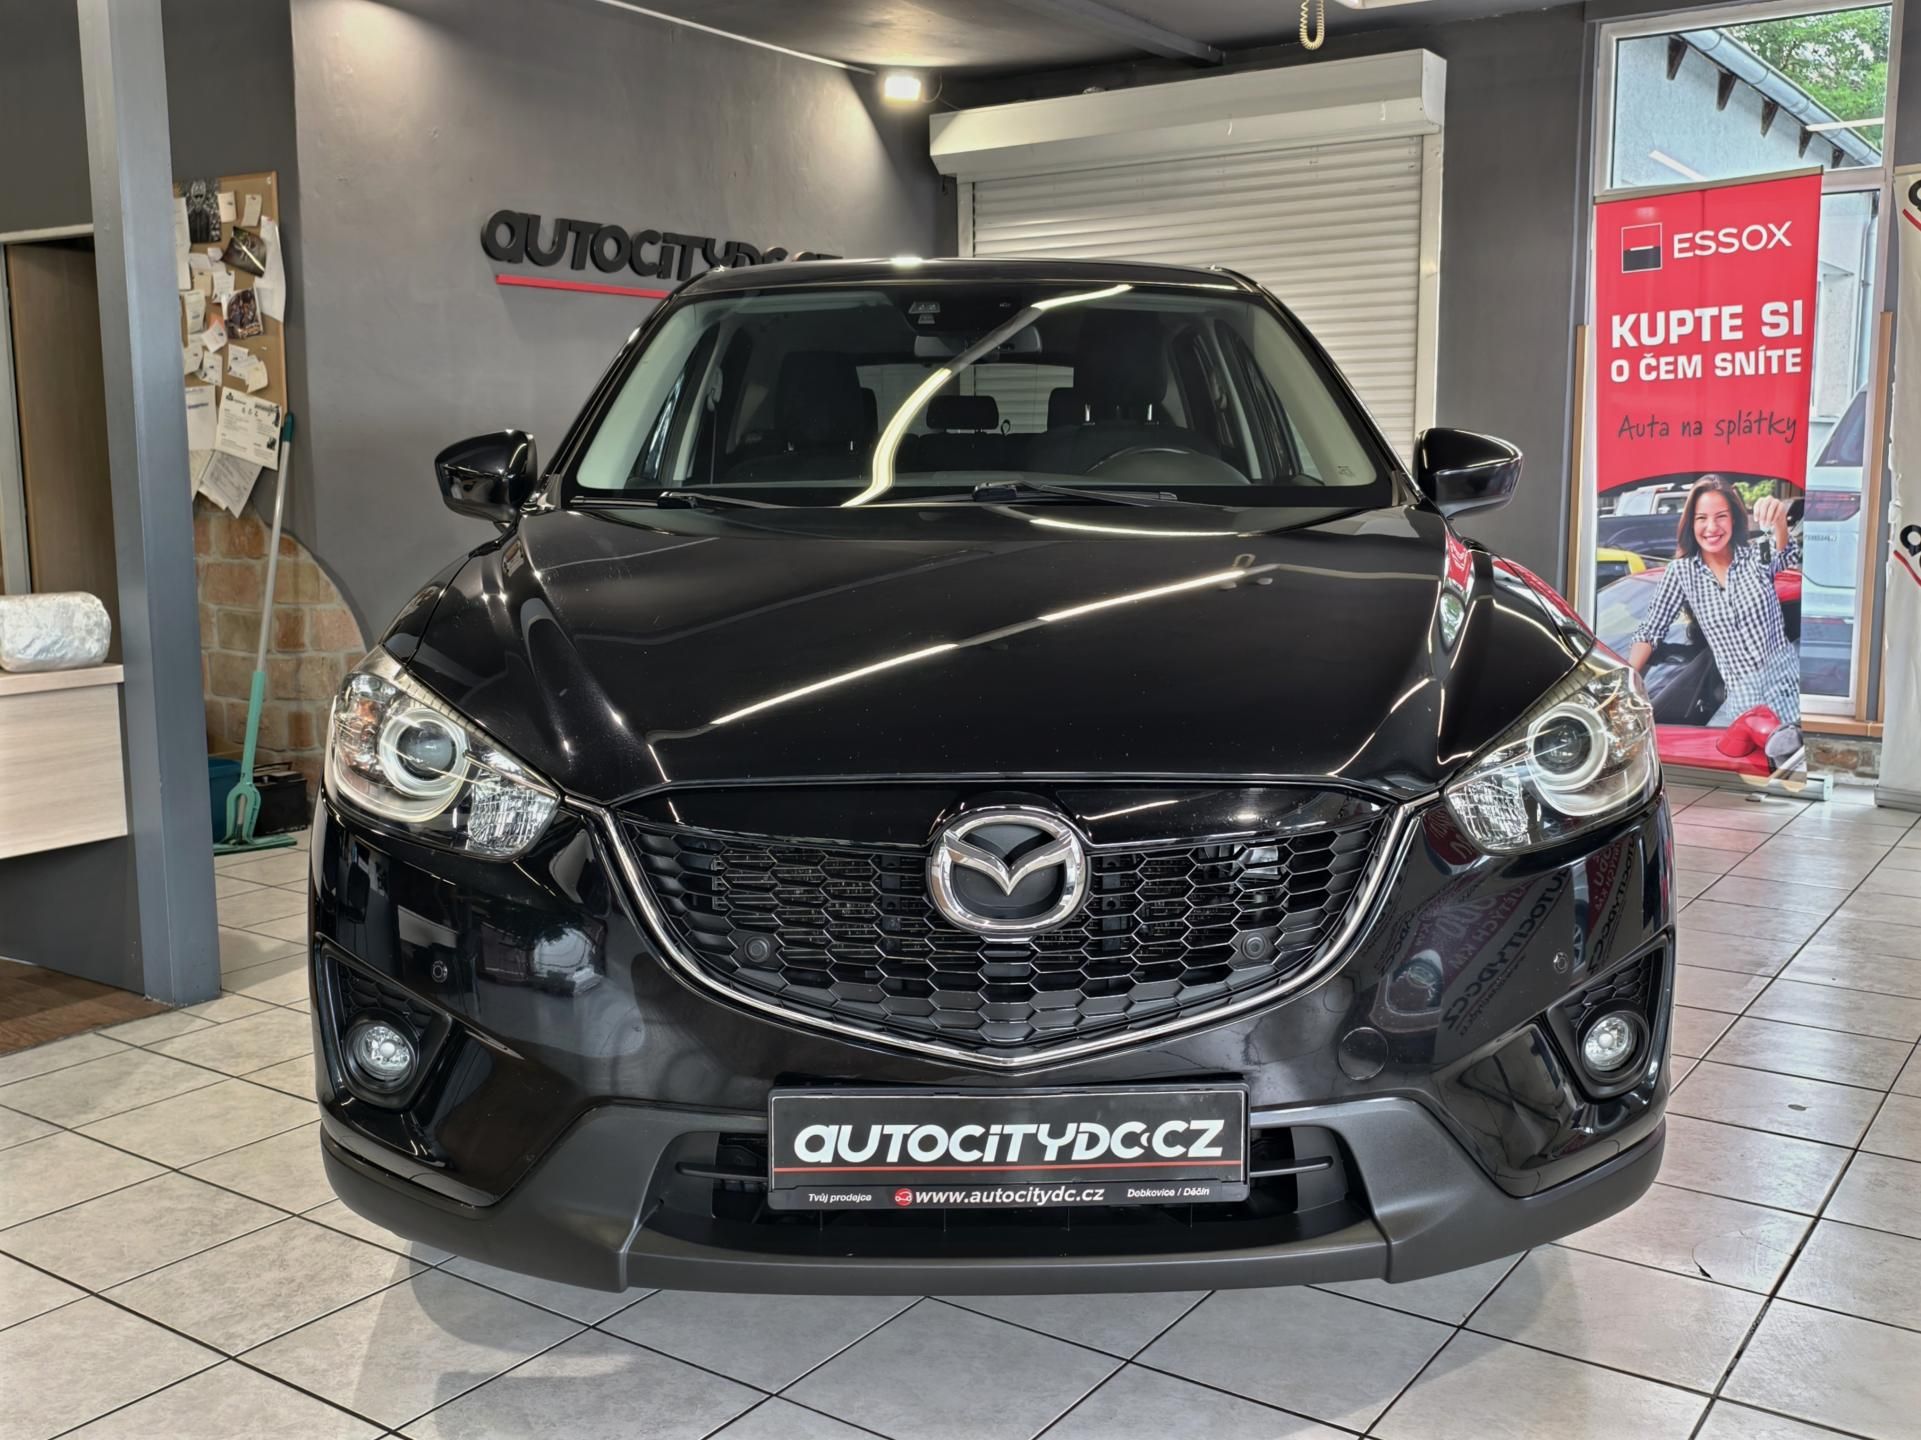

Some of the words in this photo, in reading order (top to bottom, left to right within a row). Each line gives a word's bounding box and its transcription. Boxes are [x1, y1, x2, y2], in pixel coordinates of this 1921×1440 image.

[1673, 221, 1792, 258] ESSOX
[1612, 305, 1743, 348] KUPTE
[1761, 300, 1803, 337] SI
[1611, 359, 1629, 382] O
[1639, 353, 1702, 381] ČEM
[1714, 346, 1802, 377] SNÍTE
[1618, 415, 1669, 440] Auta
[1681, 420, 1703, 437] na
[1714, 410, 1797, 444] splátky
[829, 1193, 872, 1204] prodejce
[915, 1186, 1105, 1205] www.autocitydc.cz
[1127, 1187, 1175, 1198] Dobkovice
[1183, 1187, 1210, 1197] Děčín
